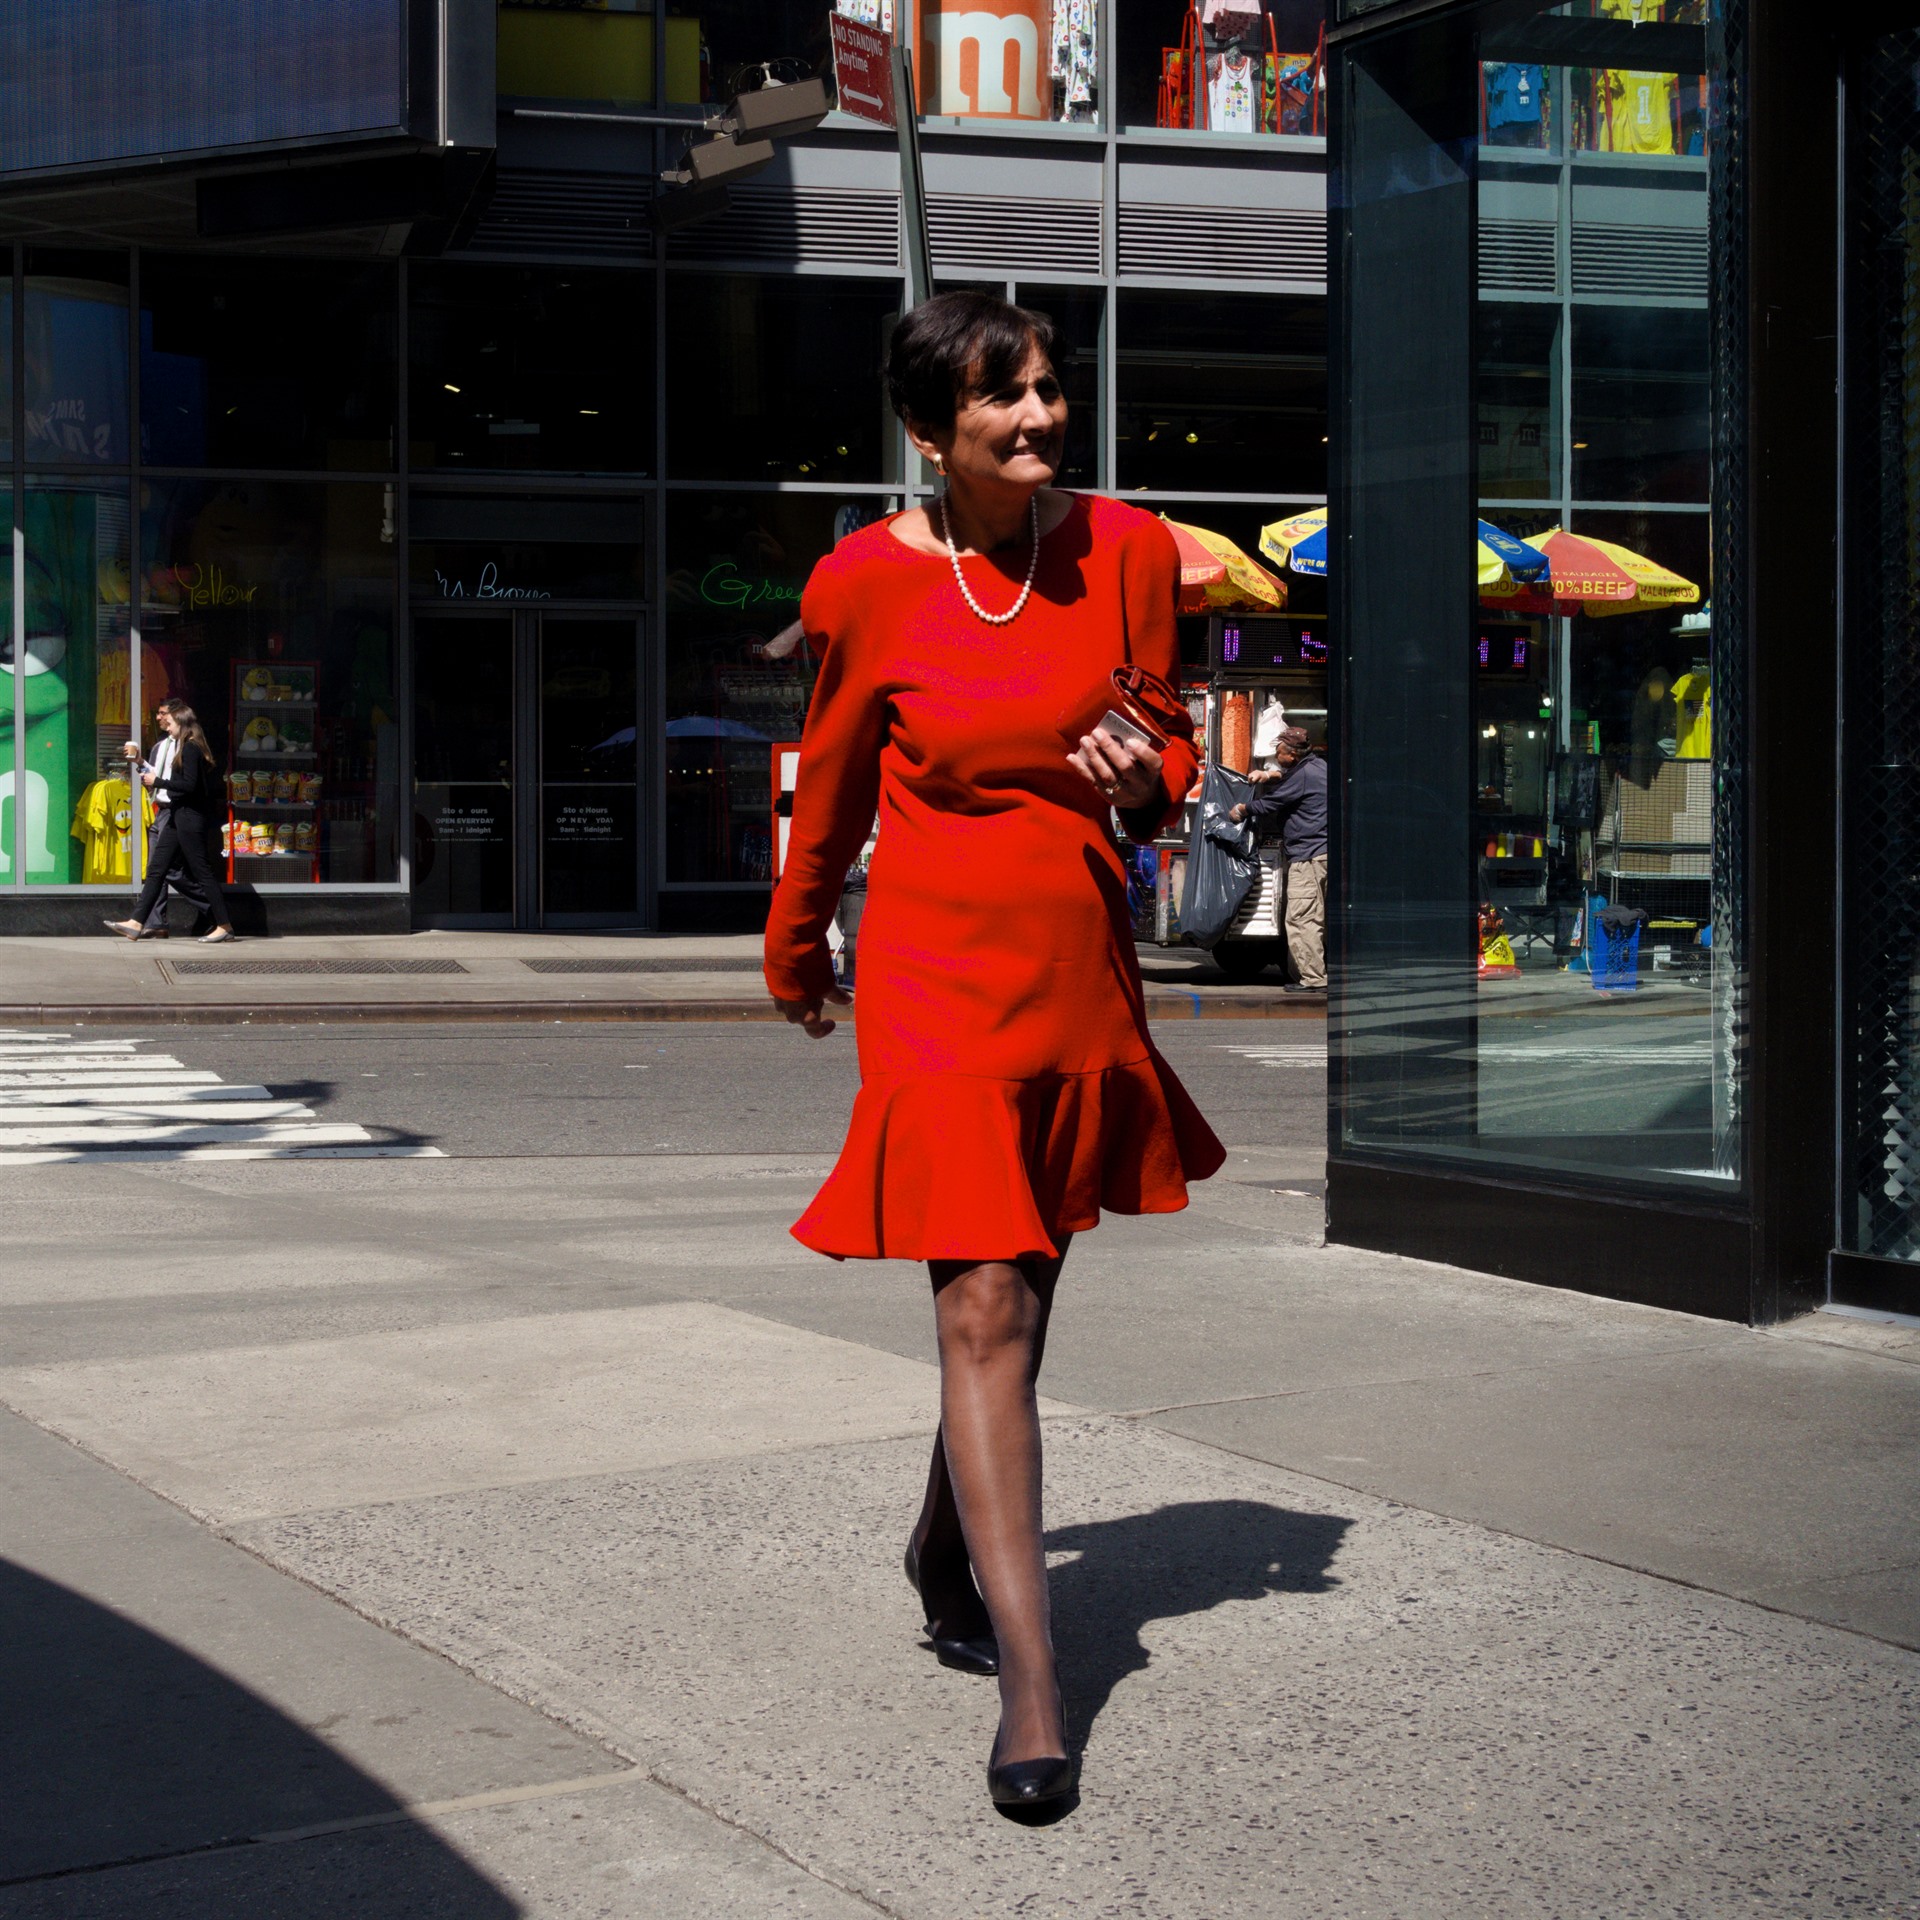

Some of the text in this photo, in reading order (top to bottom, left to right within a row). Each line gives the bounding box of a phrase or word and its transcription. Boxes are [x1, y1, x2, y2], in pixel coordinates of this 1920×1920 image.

[835, 23, 883, 57] NO STANDING
[838, 47, 869, 73] Anytime
[1182, 560, 1212, 568] AGES
[174, 561, 258, 612] Yellow
[700, 562, 802, 611] Gree
[1582, 580, 1627, 595] BEEF
[1640, 585, 1695, 598] HALAL FOOD
[441, 807, 489, 815] Stoe ours
[562, 806, 609, 814] Stoe Hours
[435, 817, 495, 825] OPEN EVERYDAY
